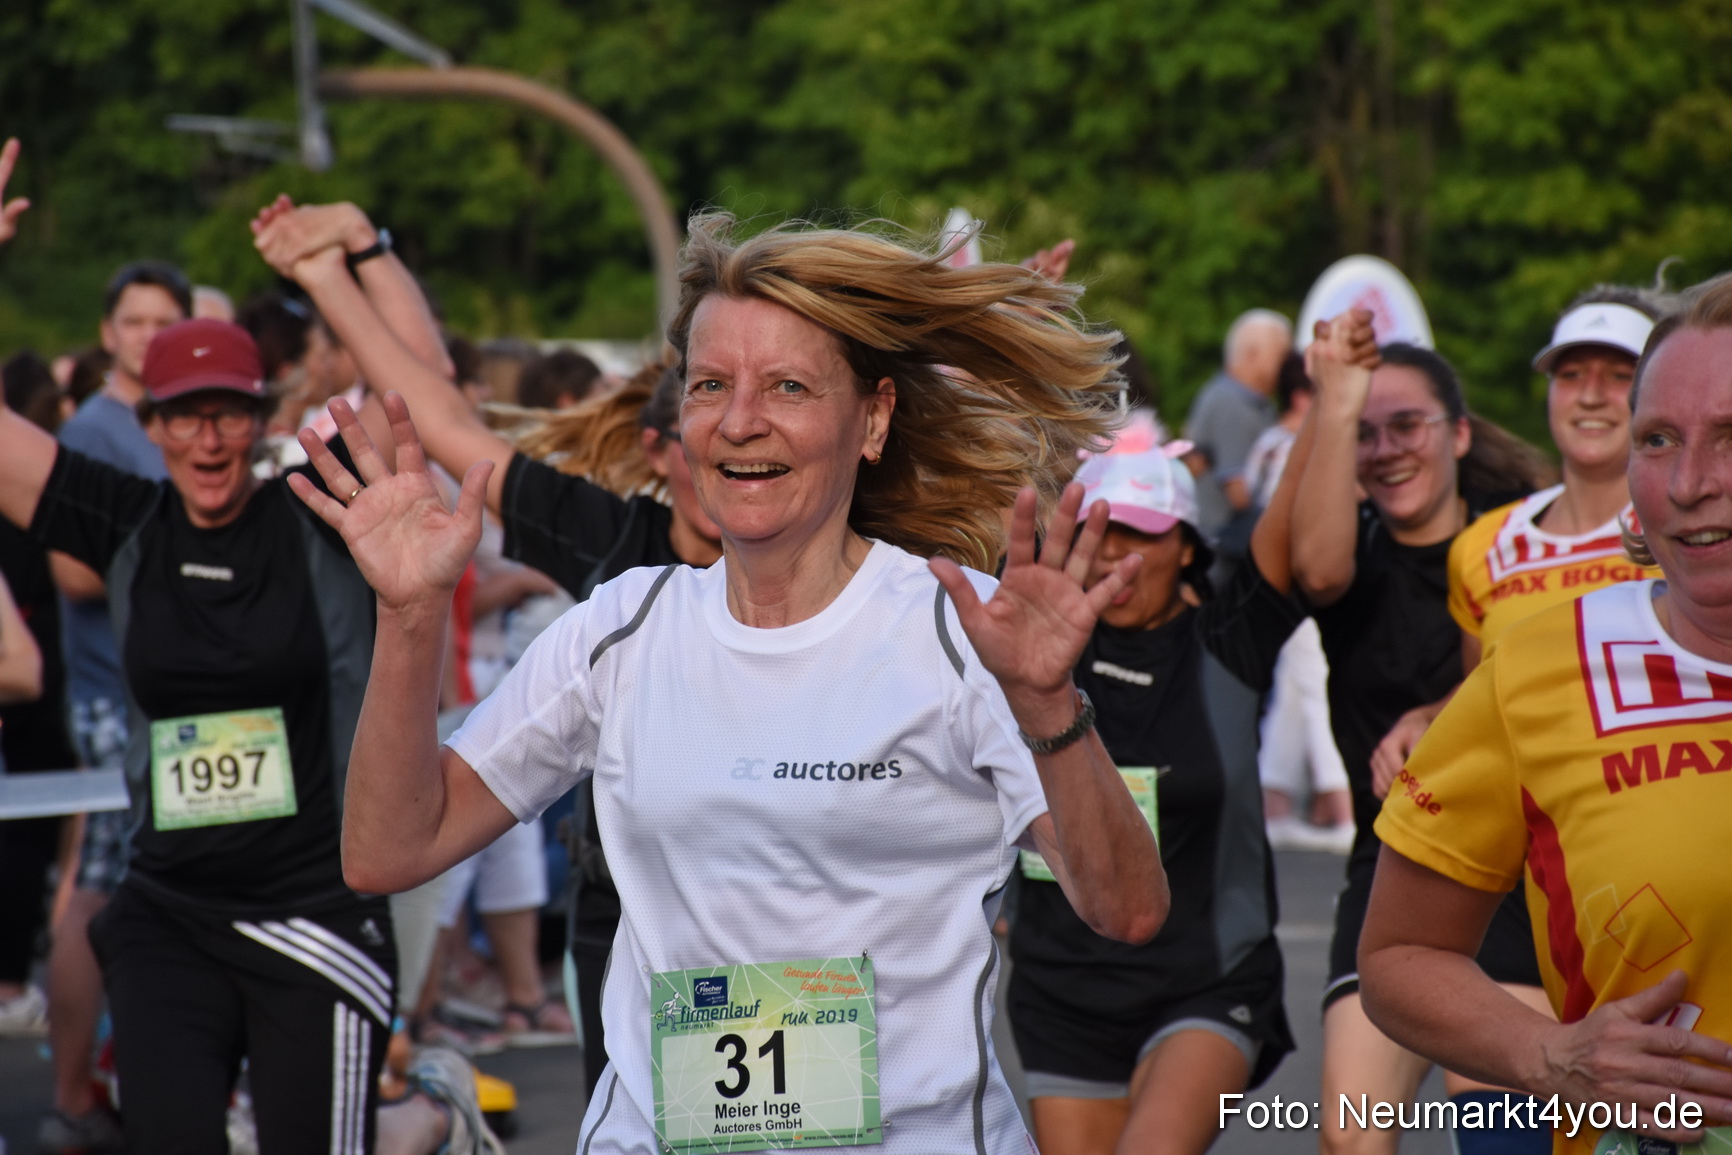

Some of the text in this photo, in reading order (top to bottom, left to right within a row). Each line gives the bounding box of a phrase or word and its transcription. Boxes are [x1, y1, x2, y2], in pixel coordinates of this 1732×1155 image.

[171, 751, 265, 794] 1997
[773, 759, 902, 781] auctores
[783, 966, 823, 980] Gesunde
[680, 999, 762, 1024] firmenlauf
[815, 1008, 858, 1025] 2019
[680, 1021, 714, 1031] neumarkt
[714, 1030, 786, 1099] 31
[714, 1101, 801, 1119] Meier Inge
[713, 1118, 803, 1135] Auctores GmbH
